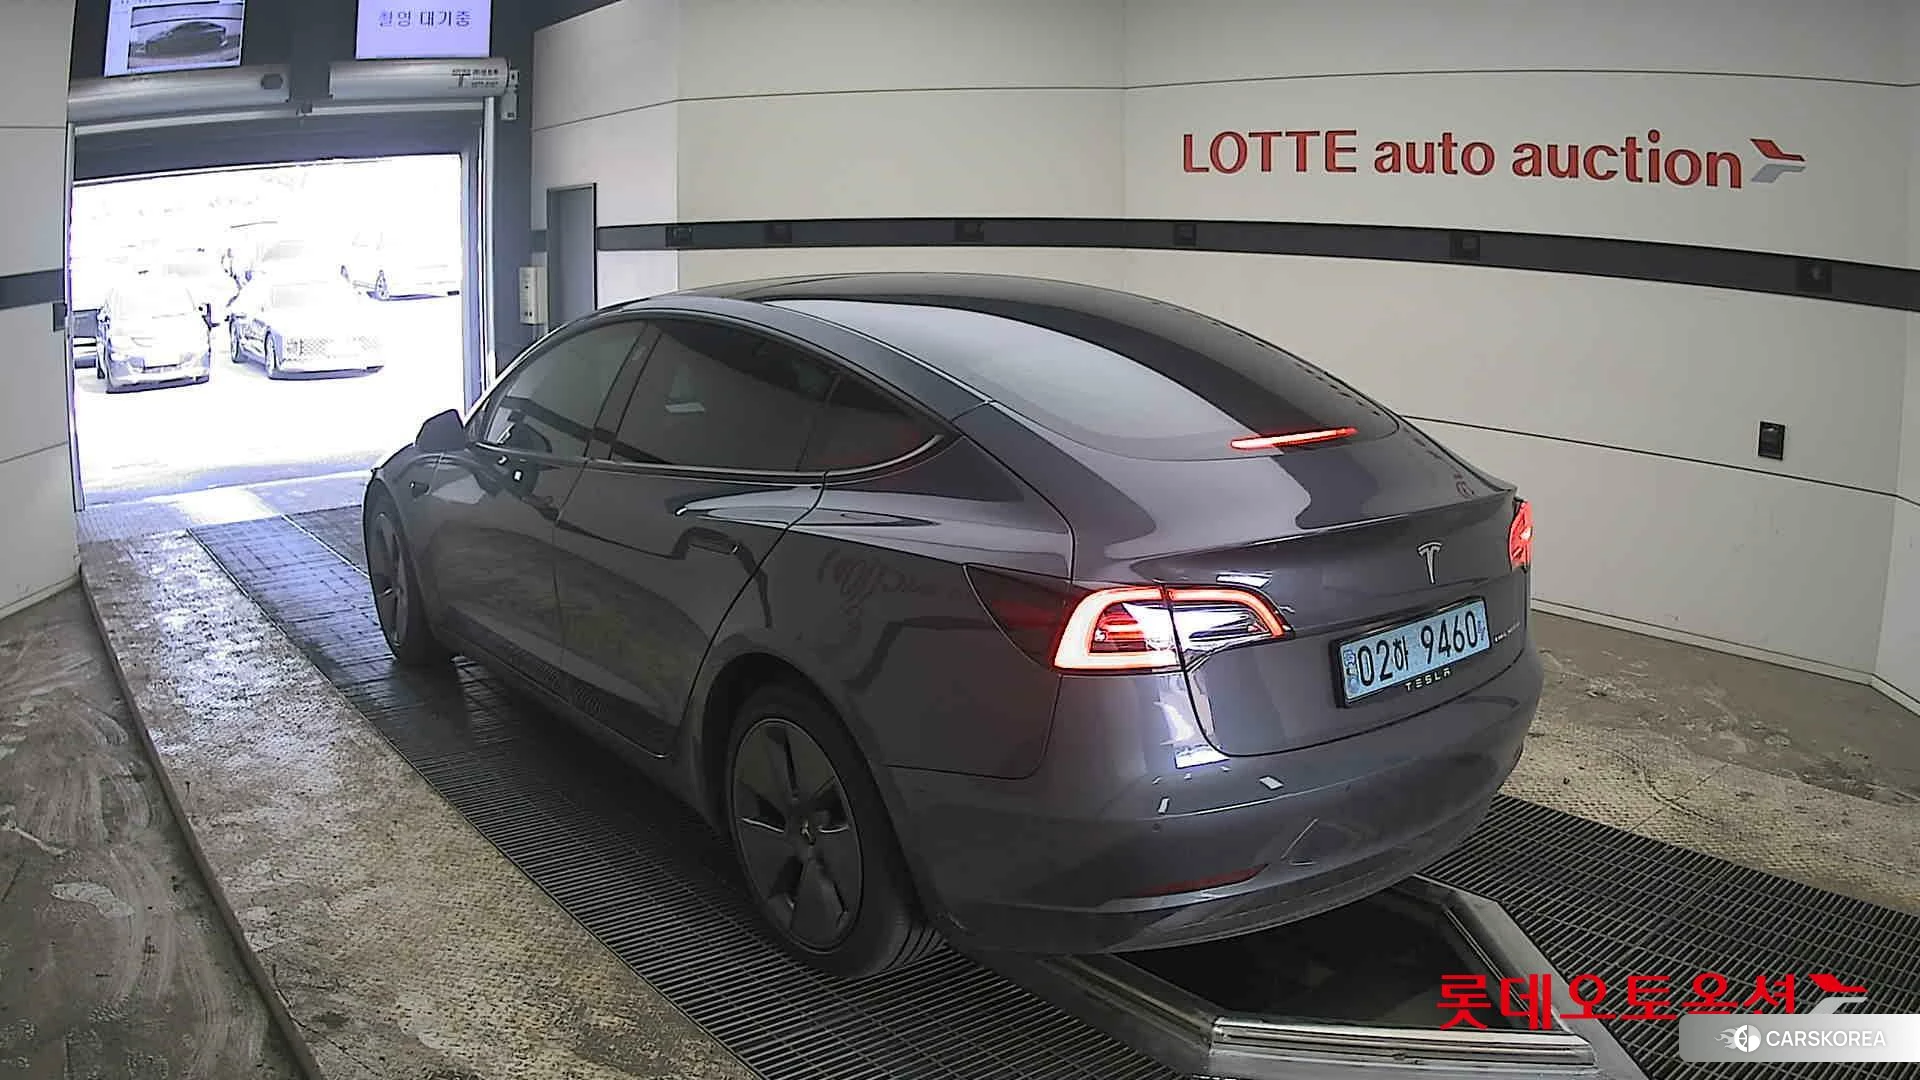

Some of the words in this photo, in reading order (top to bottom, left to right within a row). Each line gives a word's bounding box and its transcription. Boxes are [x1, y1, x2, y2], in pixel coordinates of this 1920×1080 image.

[1182, 130, 1358, 174] LOTTE
[1374, 132, 1495, 177] auto
[1512, 129, 1743, 188] auction
[1357, 635, 1409, 687] 02하
[1420, 610, 1478, 665] 9460
[1405, 667, 1452, 692] TESLA
